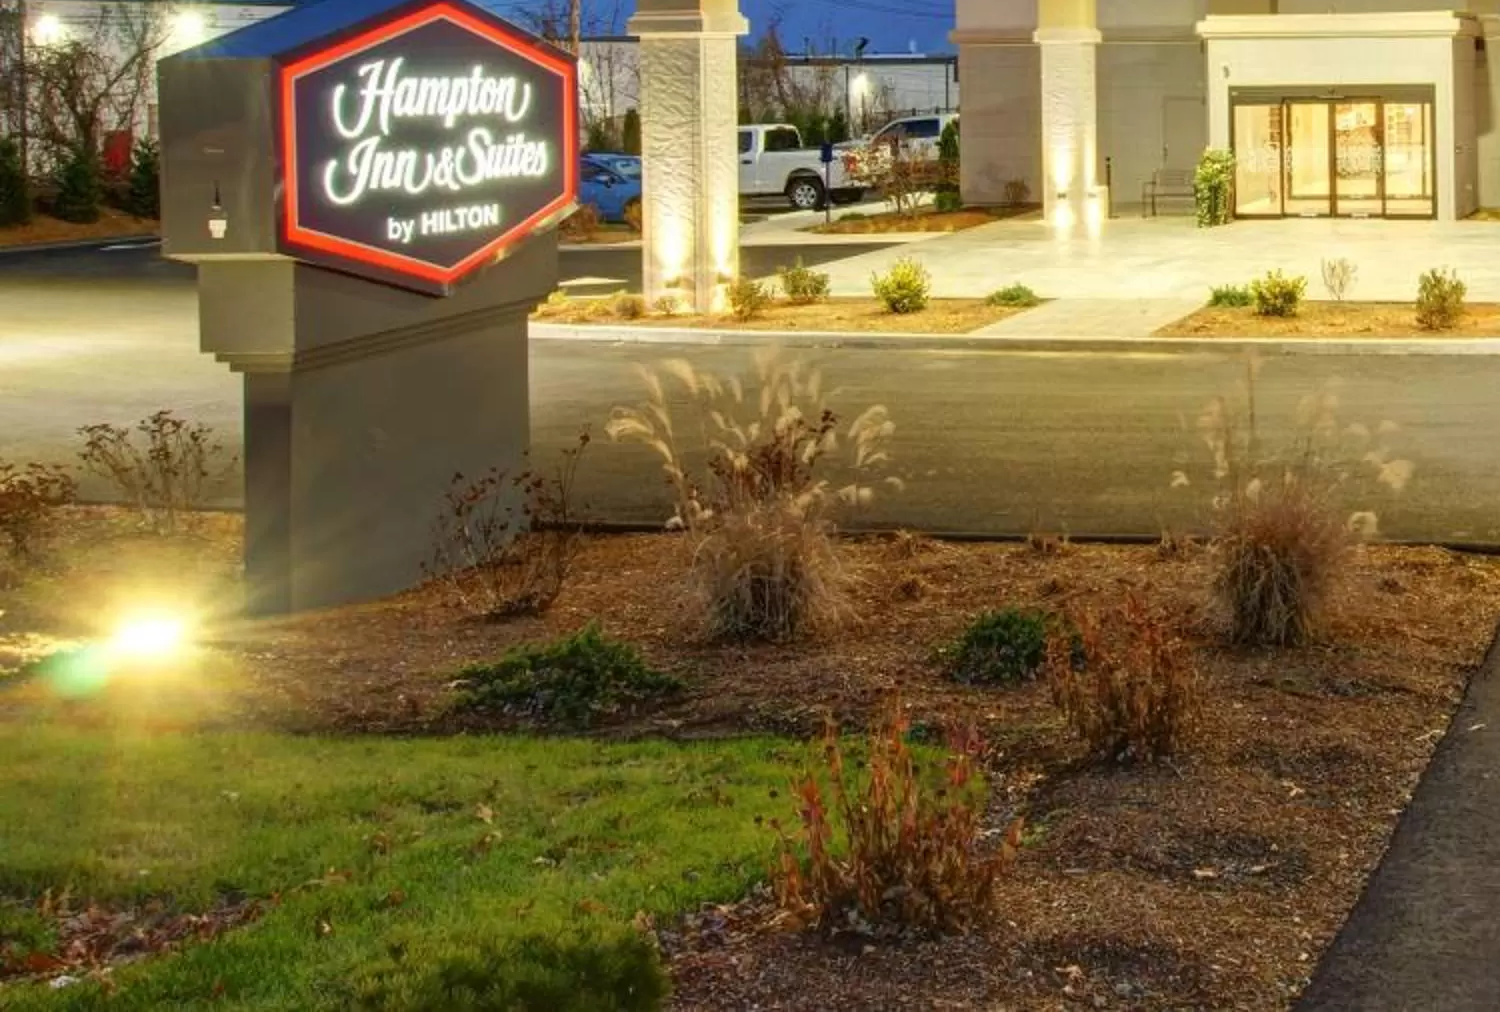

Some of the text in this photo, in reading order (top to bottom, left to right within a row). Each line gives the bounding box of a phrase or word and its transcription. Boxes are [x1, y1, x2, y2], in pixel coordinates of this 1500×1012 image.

[332, 56, 531, 137] Hampton
[323, 136, 433, 205] Inn
[455, 128, 547, 185] Suites
[387, 203, 499, 243] by HILTON
